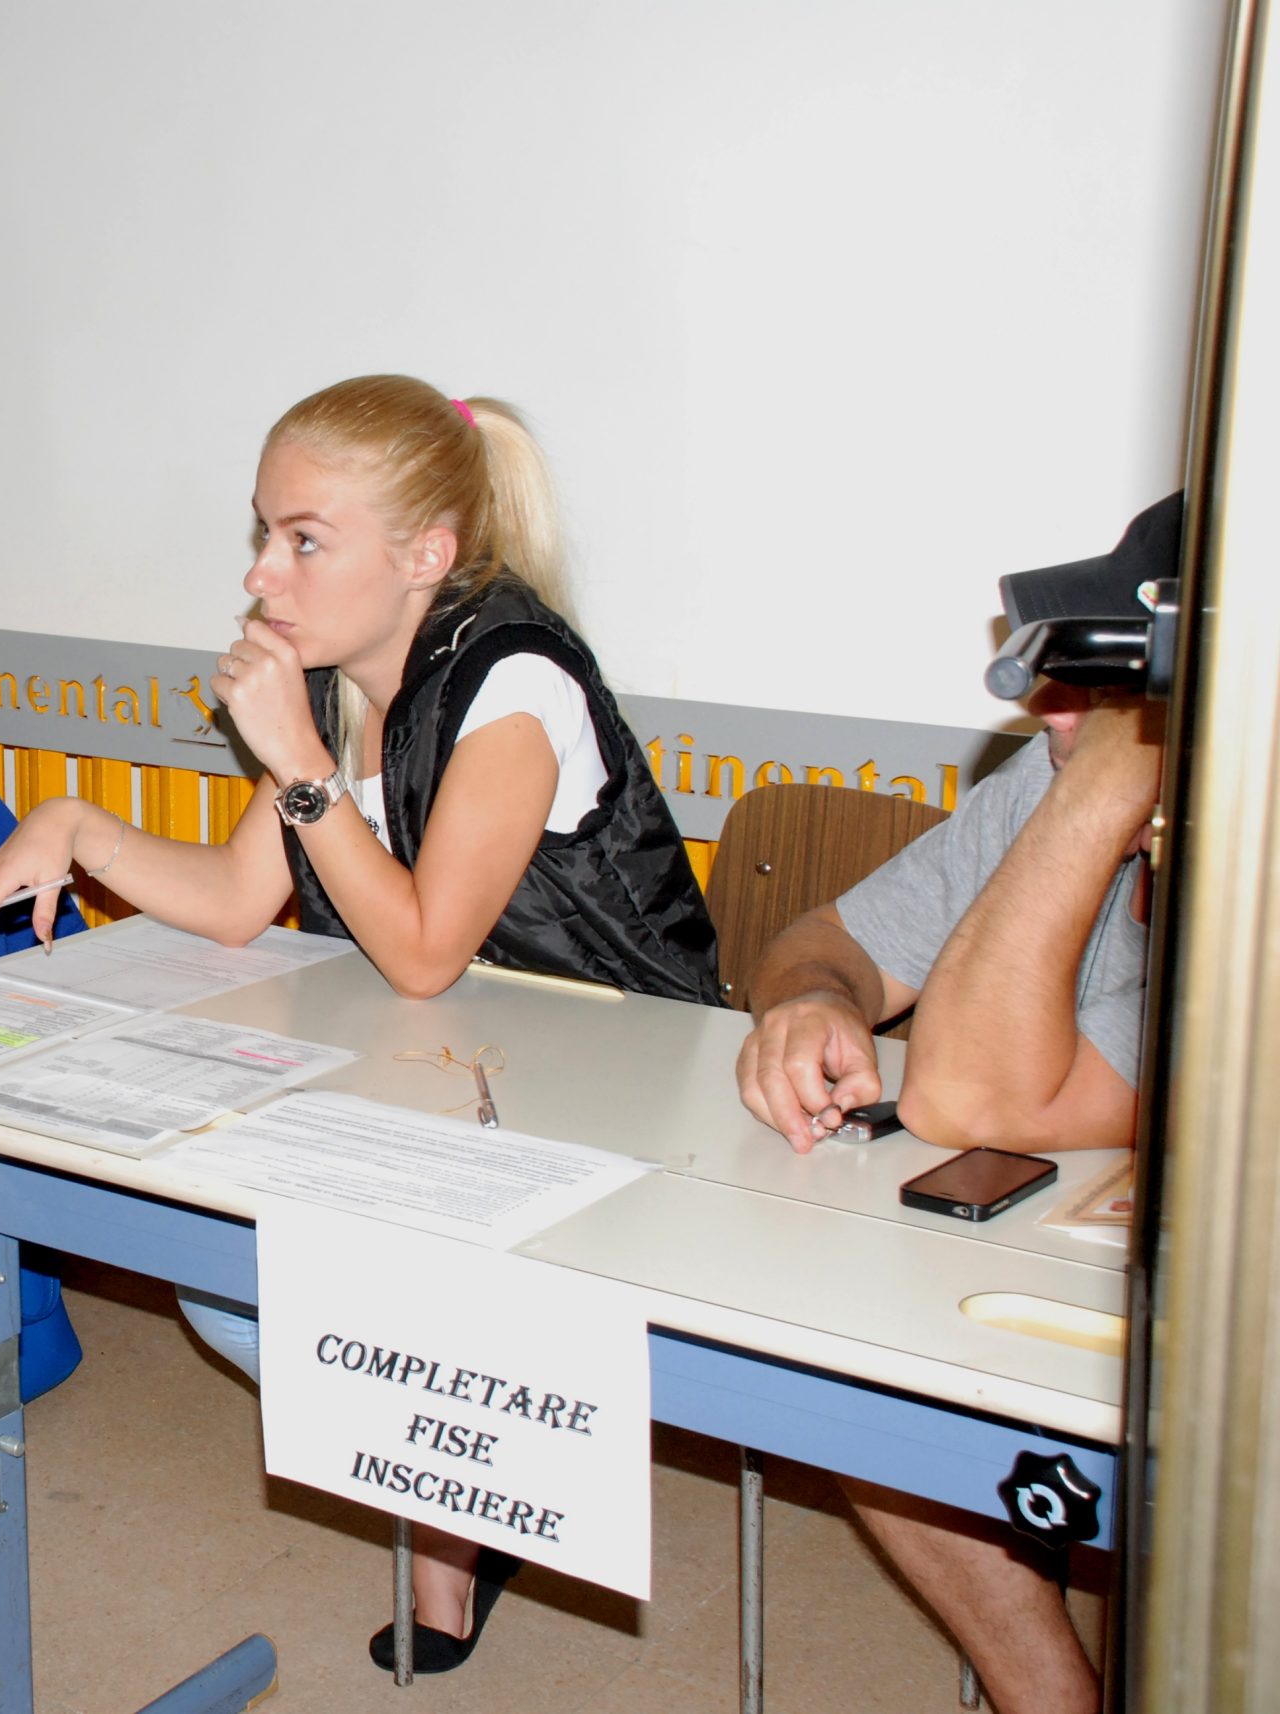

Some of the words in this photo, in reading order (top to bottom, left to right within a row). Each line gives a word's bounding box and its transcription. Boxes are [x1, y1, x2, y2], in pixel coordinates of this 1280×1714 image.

[645, 733, 959, 811] tinental
[316, 1333, 598, 1436] COMPLETARE
[405, 1413, 499, 1467] FISE
[349, 1451, 565, 1543] INSCRIERE
